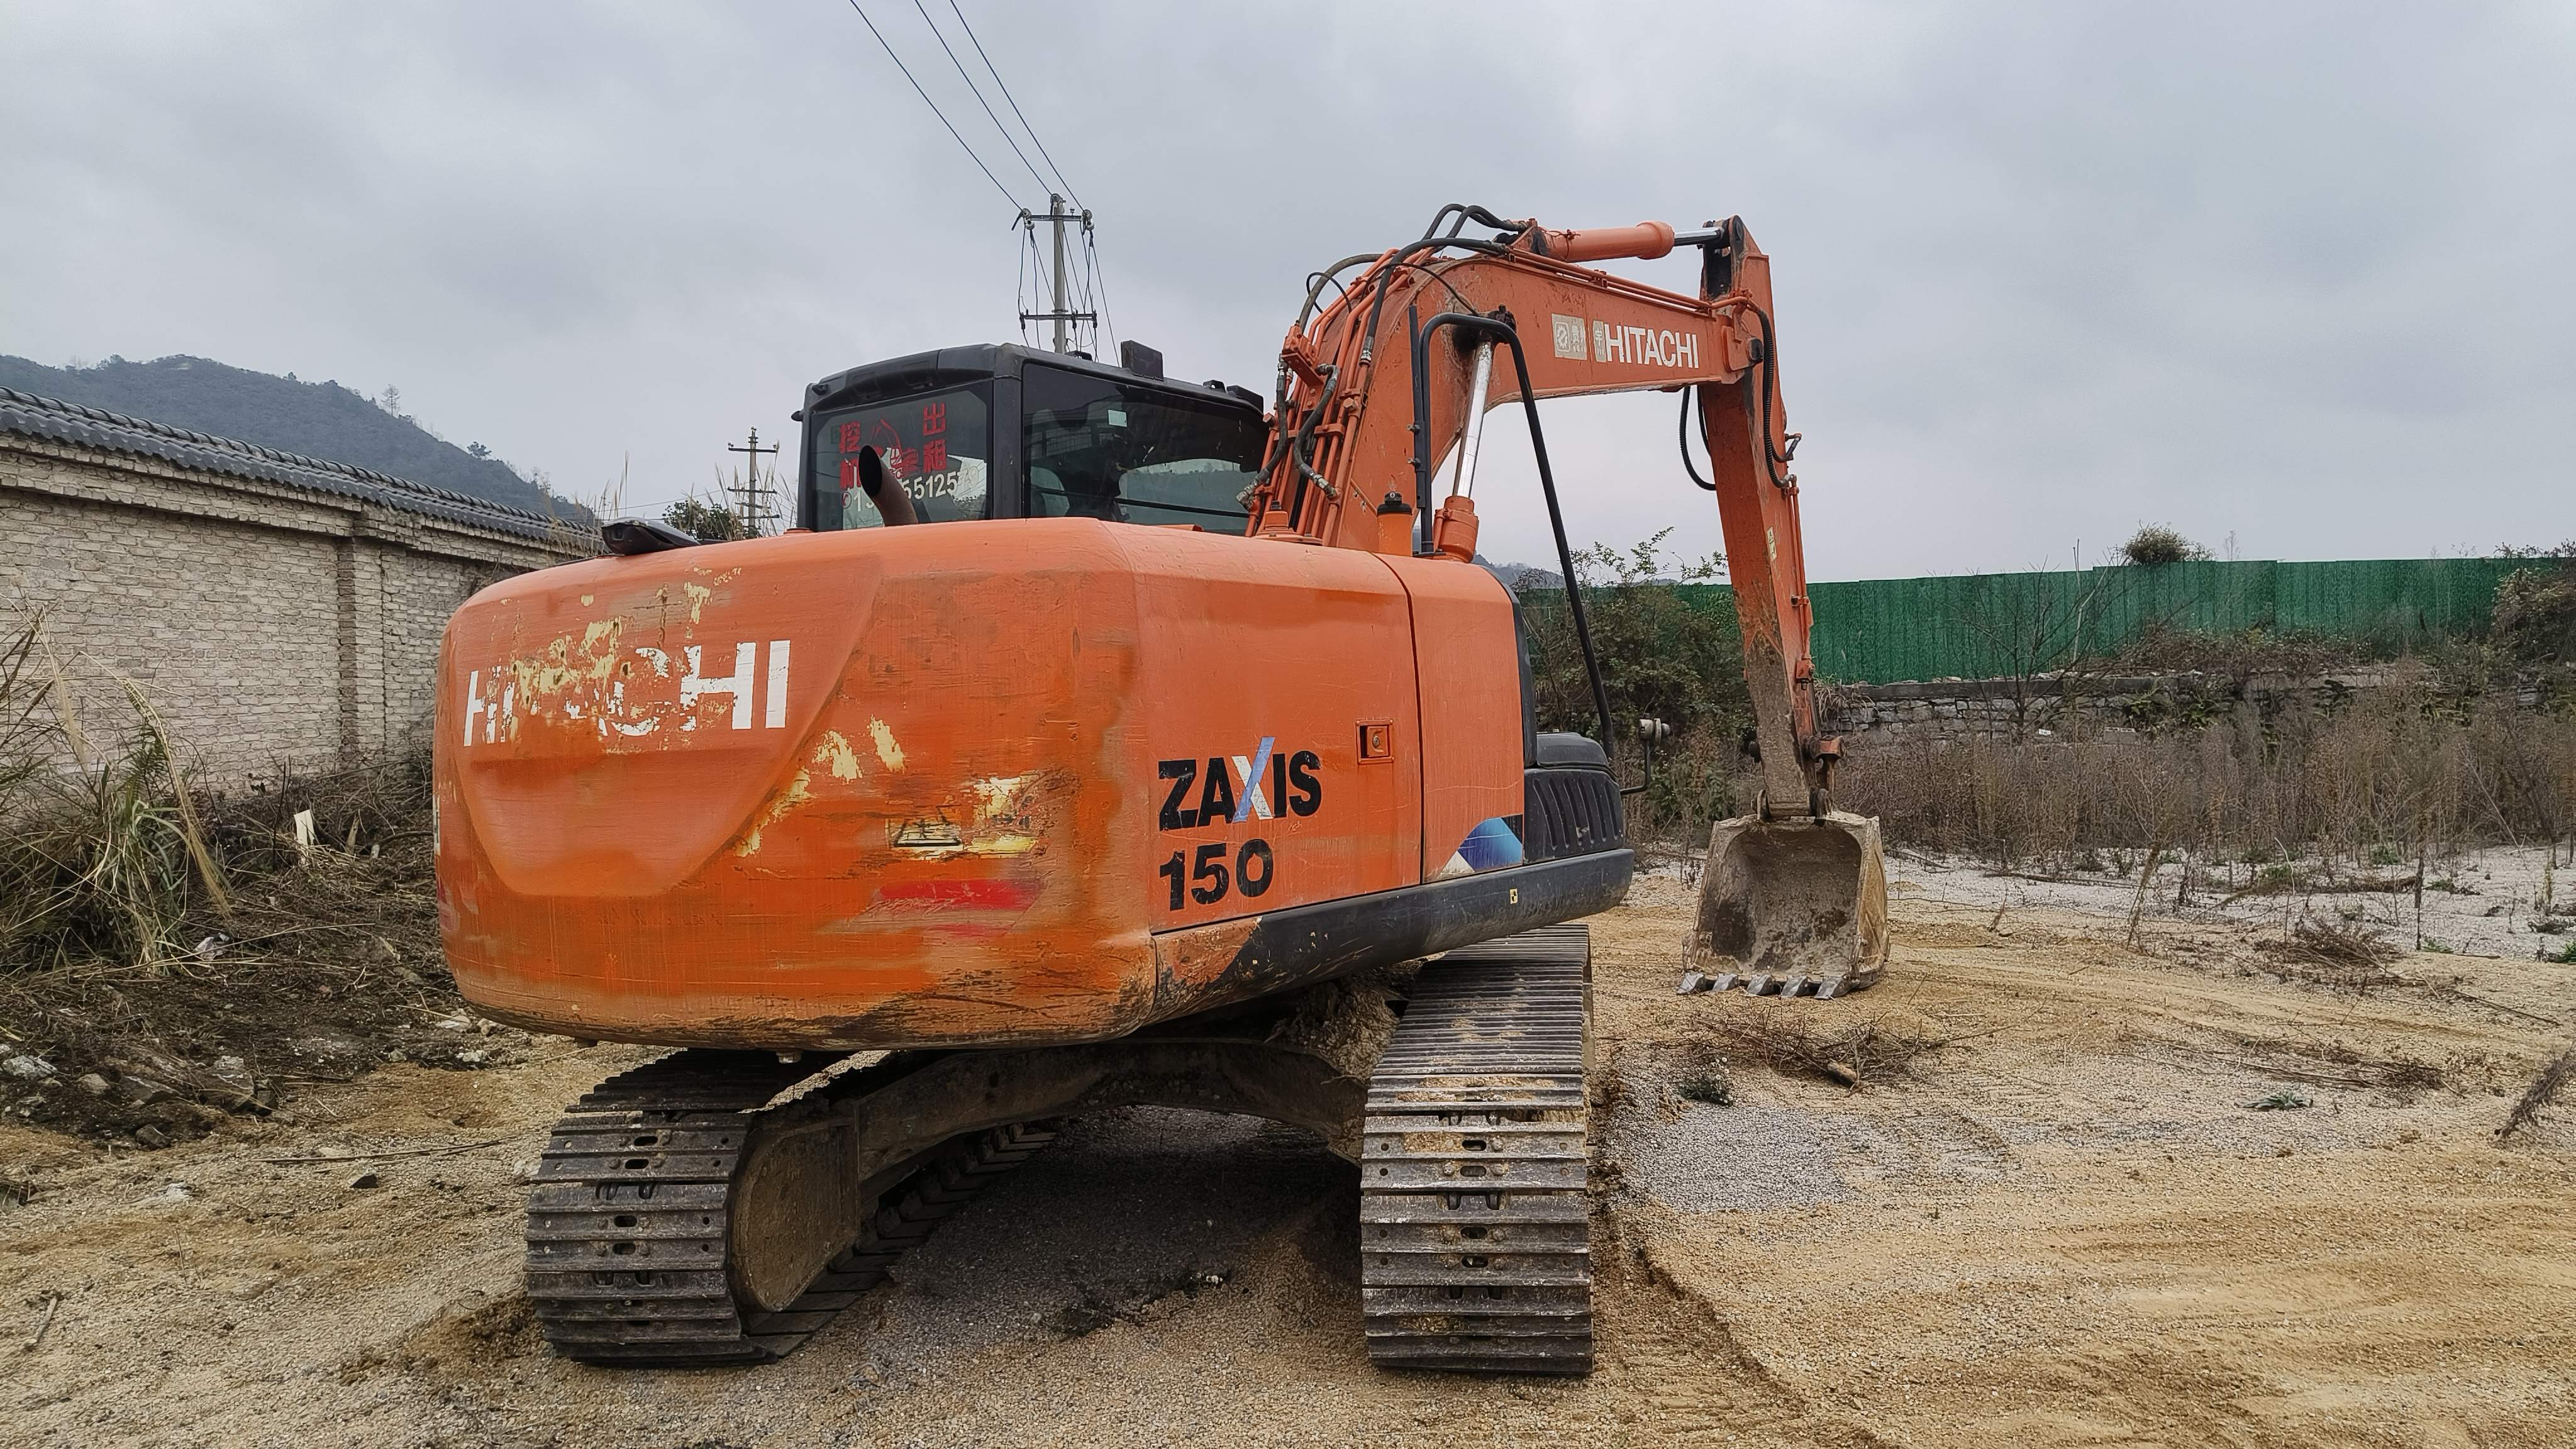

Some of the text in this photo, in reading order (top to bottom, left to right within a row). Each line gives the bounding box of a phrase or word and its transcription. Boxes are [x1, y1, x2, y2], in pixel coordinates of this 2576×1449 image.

[1604, 324, 1699, 369] HITACHI
[923, 402, 947, 474] 出租
[1158, 736, 1321, 831] ZAXIS
[1159, 838, 1274, 911] 150
